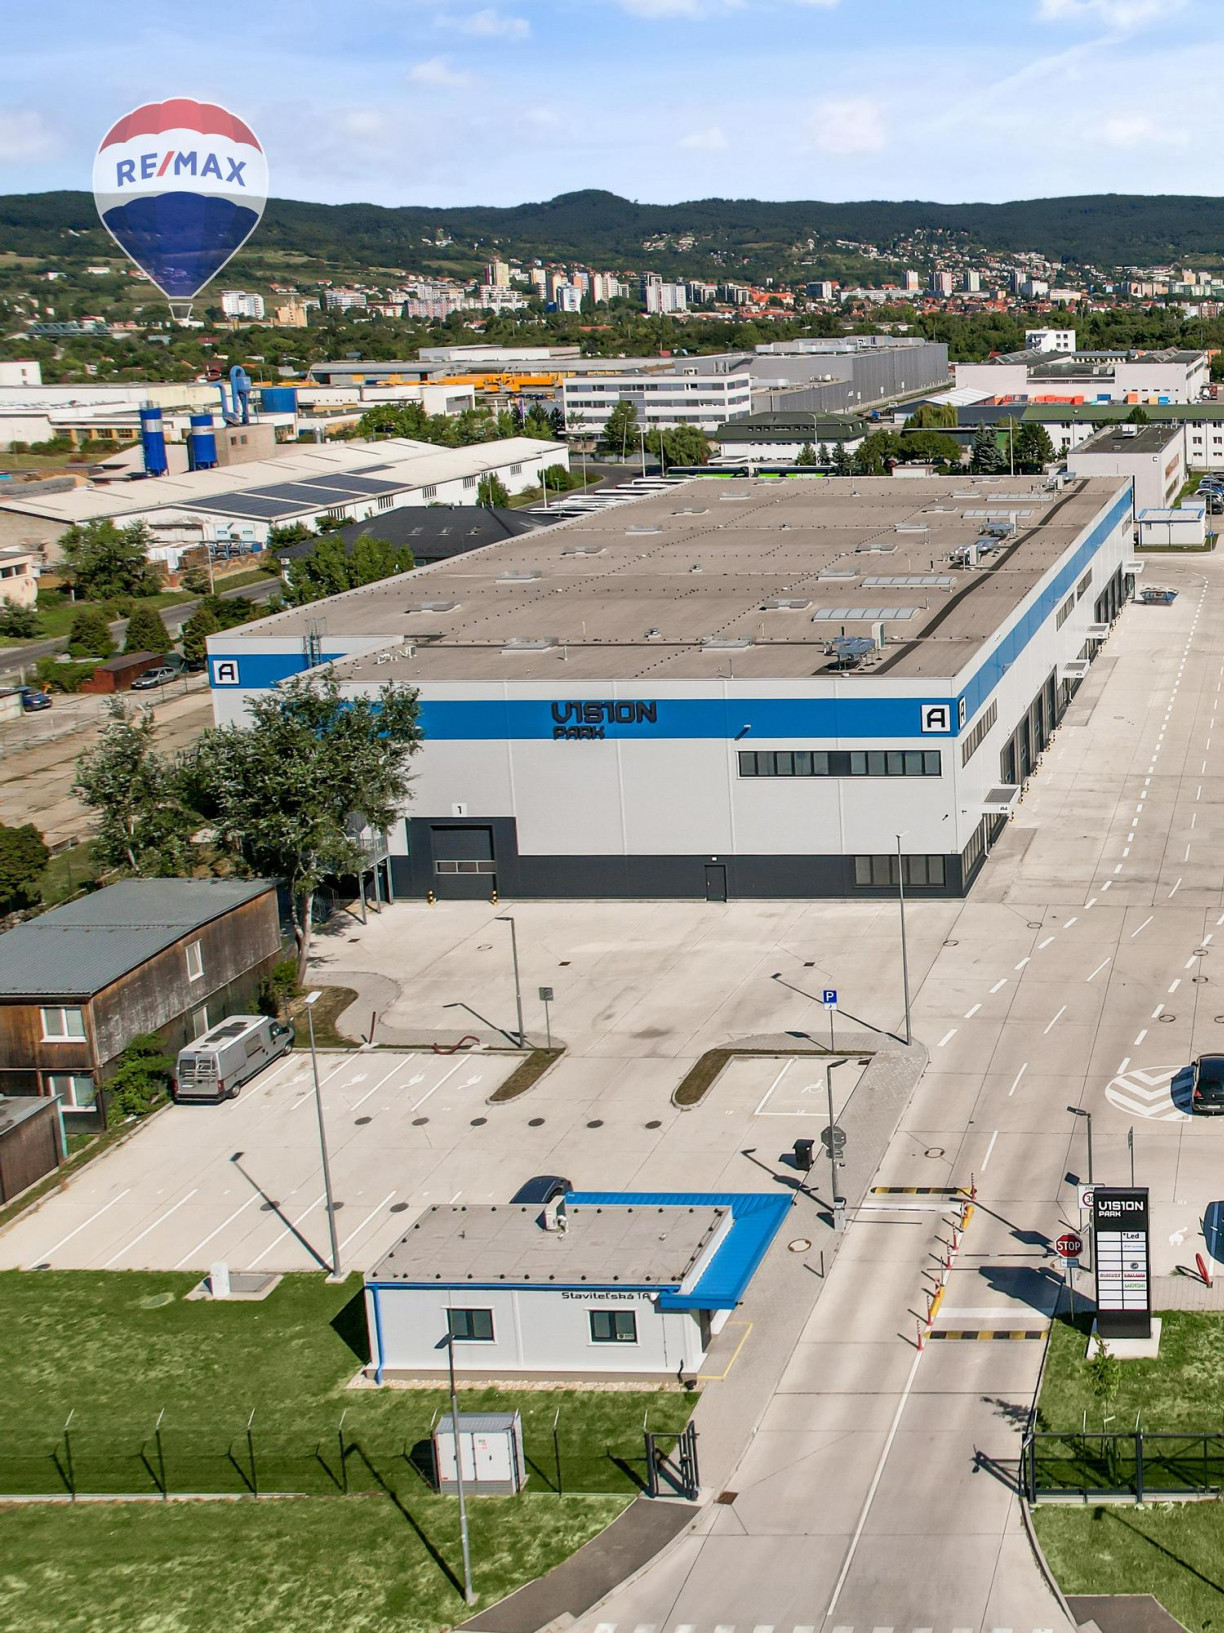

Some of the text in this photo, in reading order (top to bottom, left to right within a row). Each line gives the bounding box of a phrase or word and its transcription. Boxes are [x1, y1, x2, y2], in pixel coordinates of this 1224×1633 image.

[218, 663, 235, 680] A
[926, 708, 945, 728] A
[553, 725, 605, 740] PARK
[457, 805, 462, 815] 1
[1057, 1241, 1080, 1251] STOP
